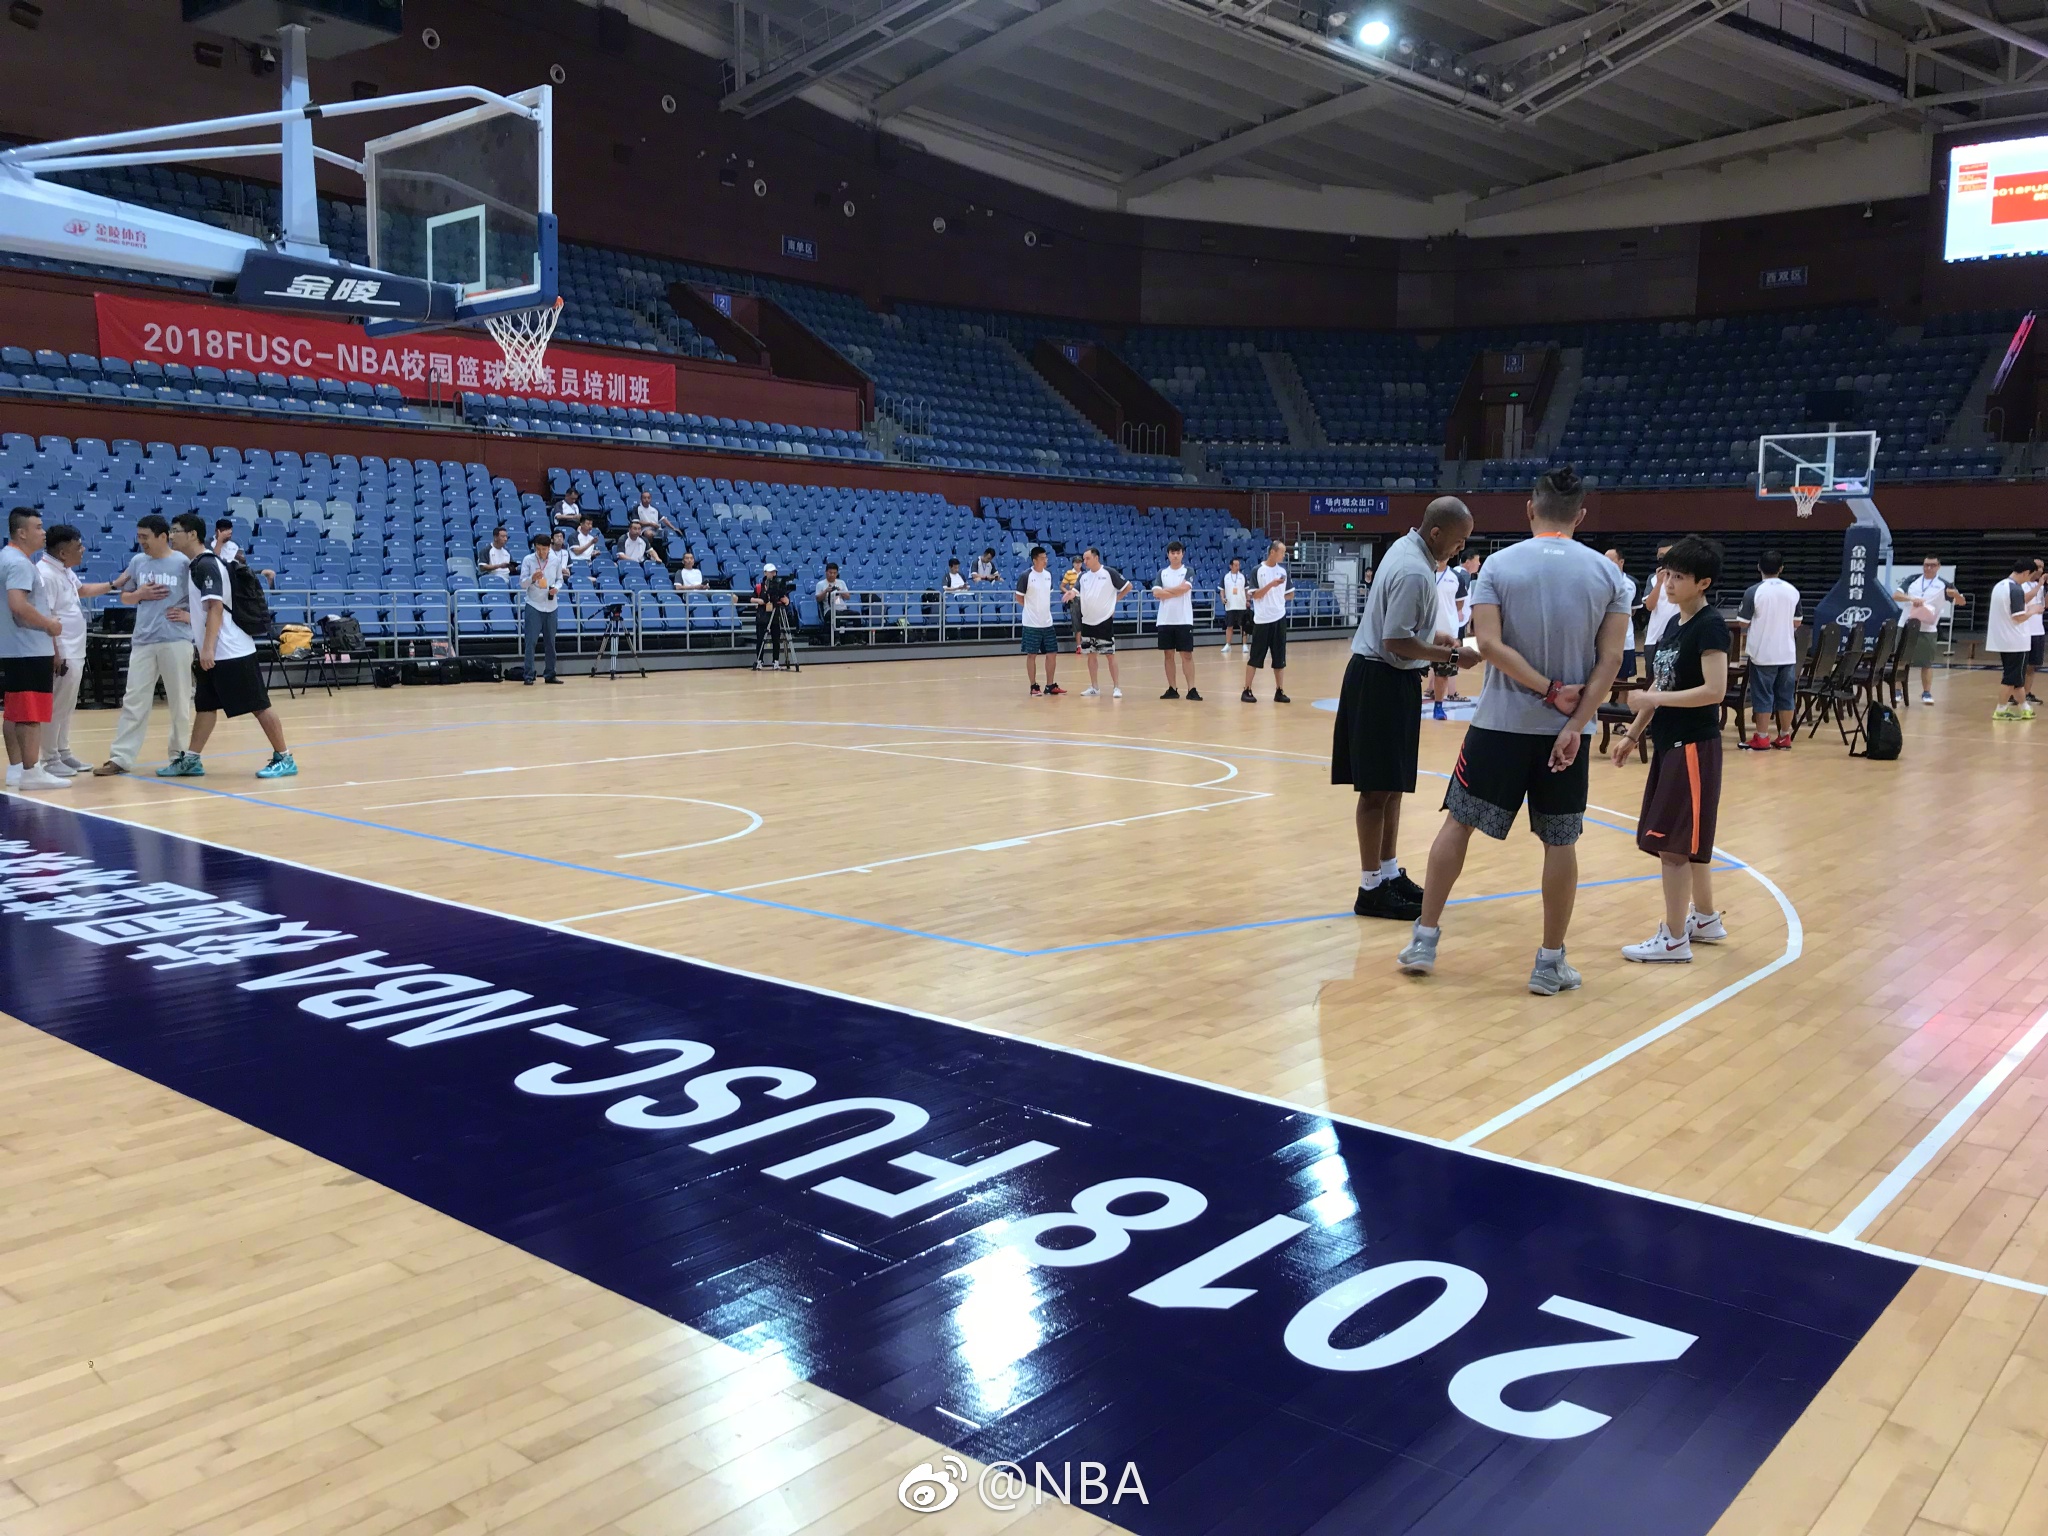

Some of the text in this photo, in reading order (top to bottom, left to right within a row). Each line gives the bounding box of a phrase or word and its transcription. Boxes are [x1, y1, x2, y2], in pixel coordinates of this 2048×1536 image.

[95, 222, 146, 243] 金陵体育
[264, 274, 400, 306] 金陵
[719, 297, 725, 308] 2
[1325, 497, 1375, 507] 场内观众出口
[1329, 506, 1357, 514] Audience
[1848, 545, 1867, 600] 金陵体育
